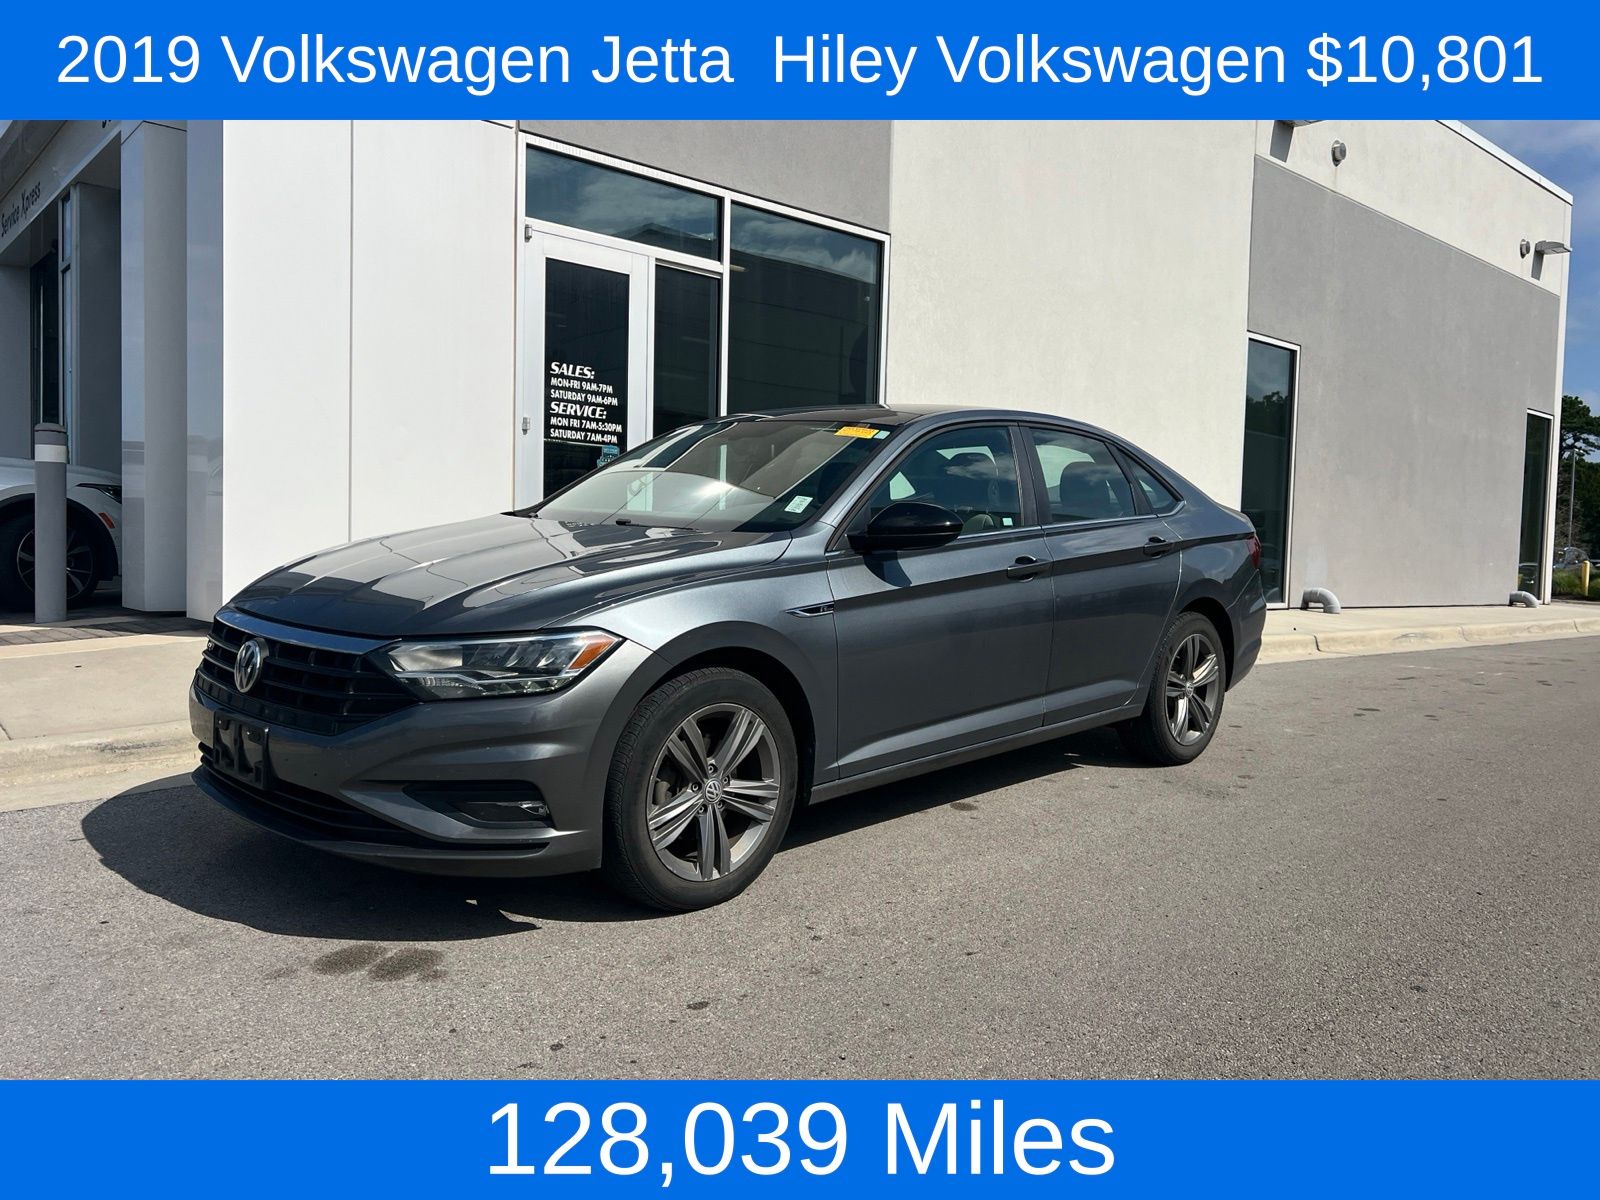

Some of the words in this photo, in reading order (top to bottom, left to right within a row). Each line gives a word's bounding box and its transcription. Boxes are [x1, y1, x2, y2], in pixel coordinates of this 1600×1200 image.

[549, 361, 595, 379] SALES:
[550, 377, 581, 389] MON-FRI
[581, 381, 613, 394] 9AM-7PM
[550, 389, 586, 402] SATURDAY
[587, 393, 618, 406] 9AM-6PM
[549, 401, 607, 419] SERVICE:
[581, 420, 623, 433] 7AM-5:30PM
[550, 428, 586, 441] SATURDAY
[586, 432, 618, 444] 7AM-4PM
